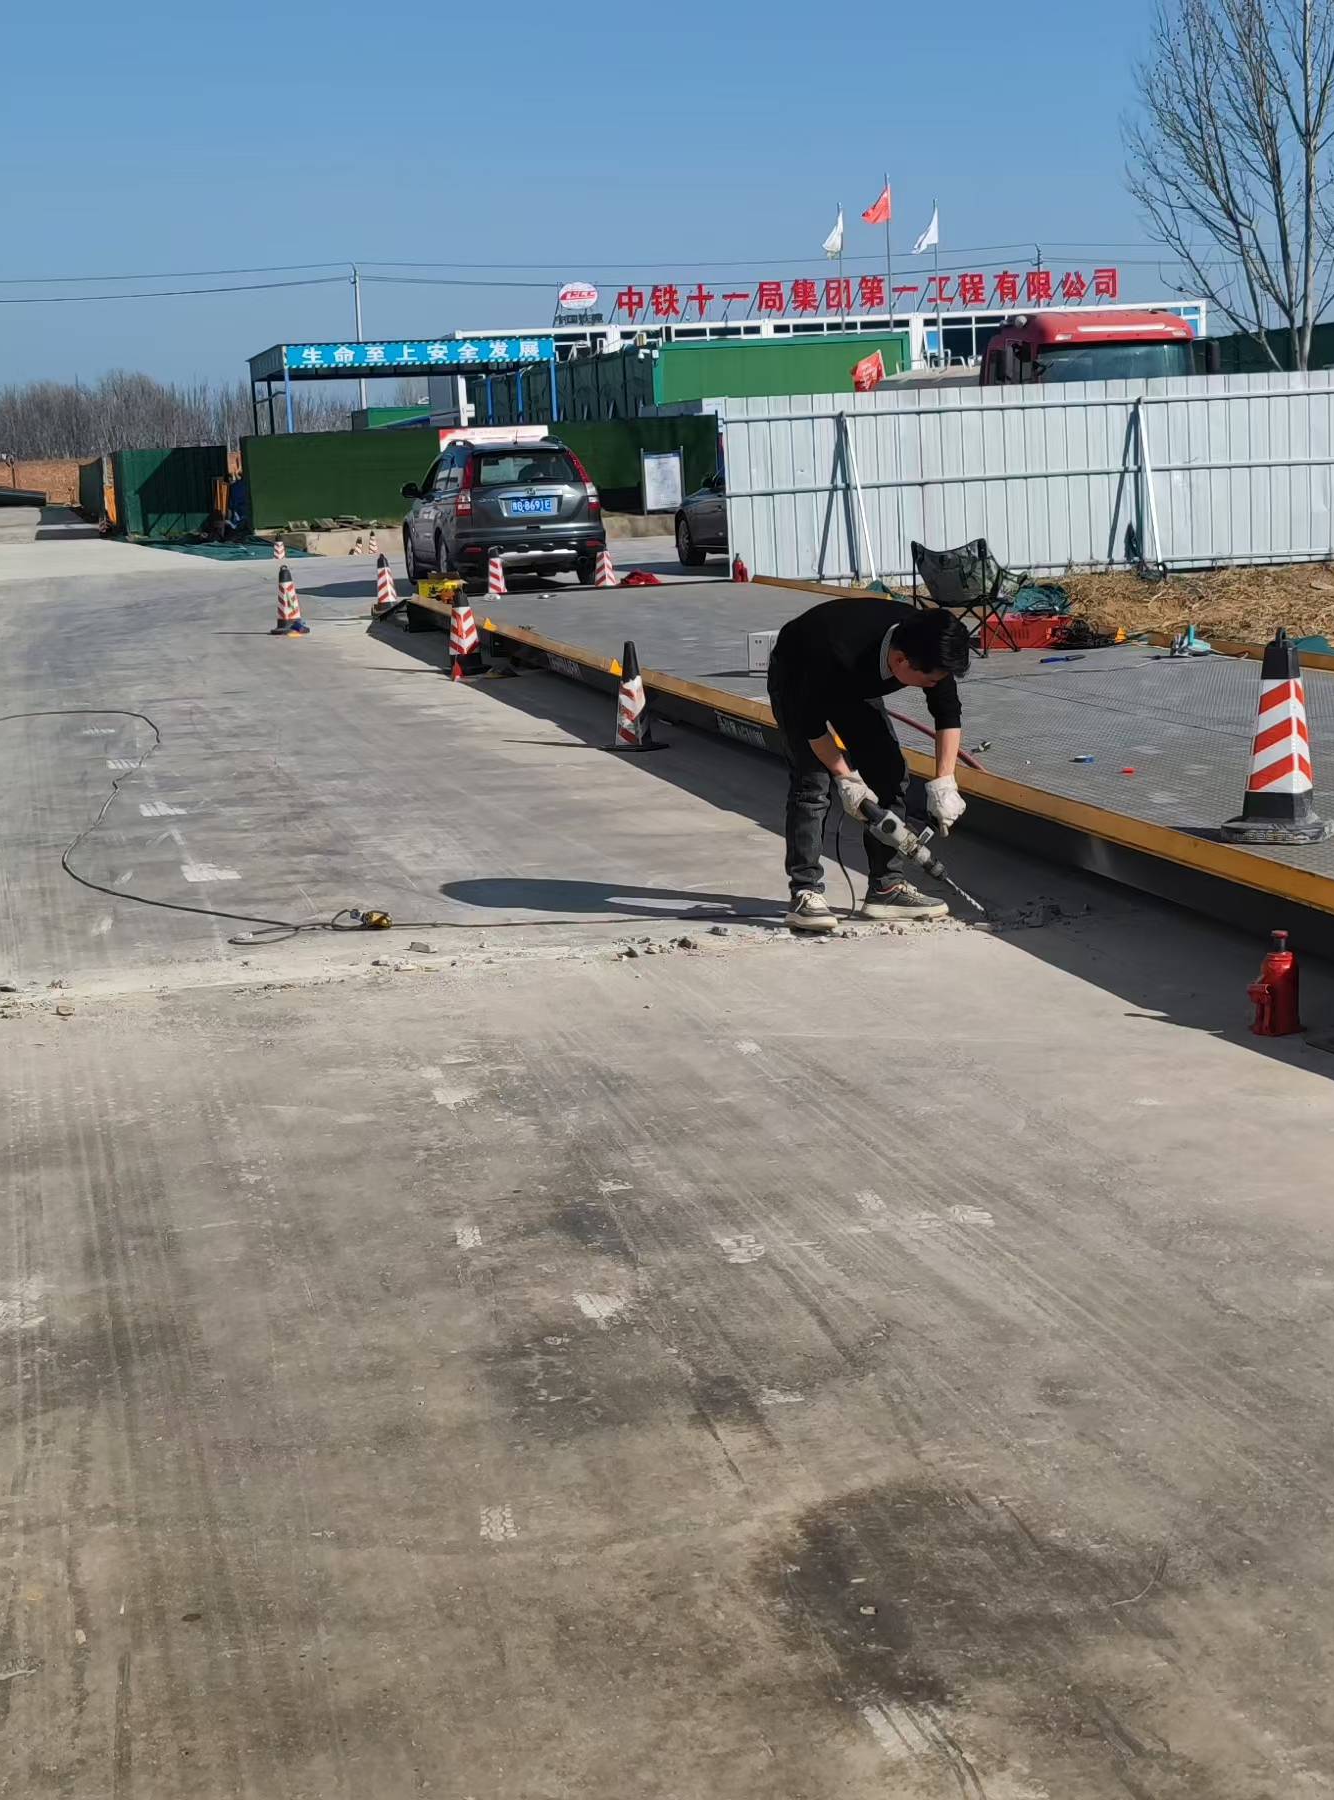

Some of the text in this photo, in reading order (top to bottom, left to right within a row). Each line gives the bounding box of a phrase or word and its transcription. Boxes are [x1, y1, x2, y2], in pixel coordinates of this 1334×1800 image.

[617, 269, 1118, 319] 中铁十一局集团第一工程有限公司
[301, 341, 540, 364] 生命至上安全发展
